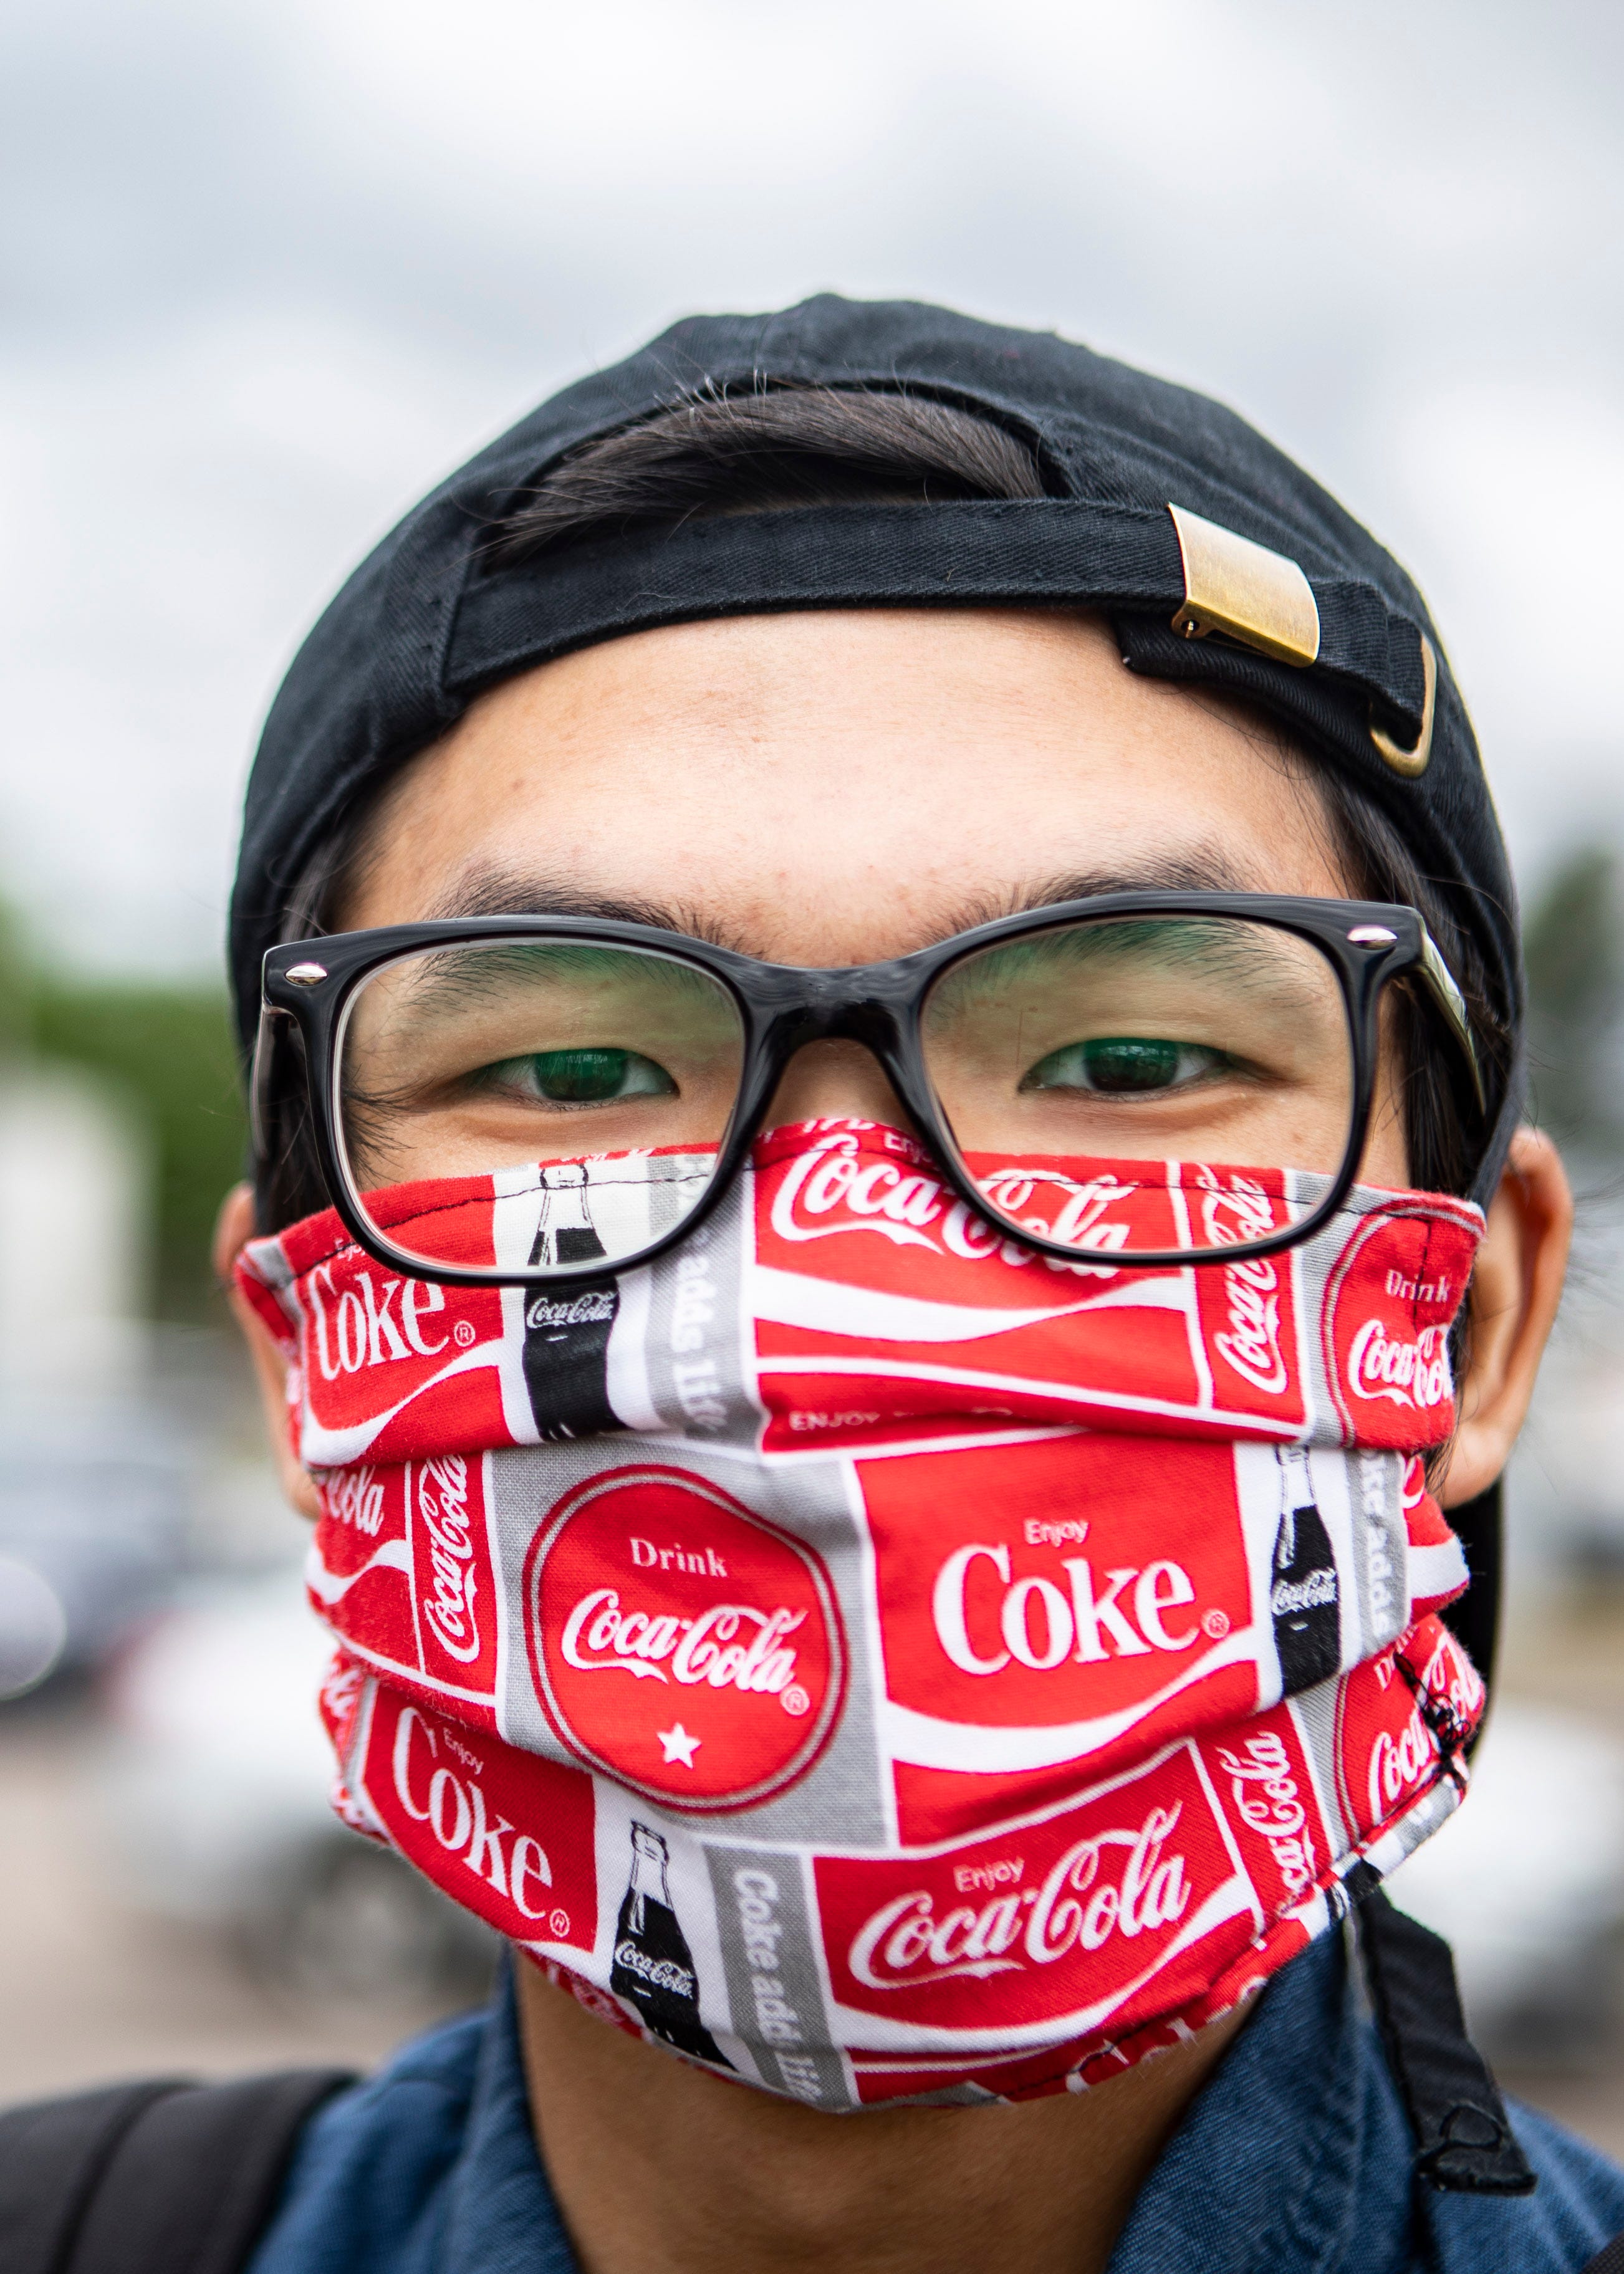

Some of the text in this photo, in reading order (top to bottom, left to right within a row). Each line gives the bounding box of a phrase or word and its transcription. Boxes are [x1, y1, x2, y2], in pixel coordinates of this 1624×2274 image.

[1385, 1268, 1451, 1303] Drink
[1023, 1516, 1090, 1548] Enjoy
[629, 1537, 729, 1578] Drink
[443, 1726, 484, 1776] Enjoy
[848, 1799, 1192, 1990] Coca-Cola
[953, 1856, 1025, 1892] Enjoy
[734, 1869, 781, 1972] Coke
[615, 1939, 696, 2000] Coca-Cola
